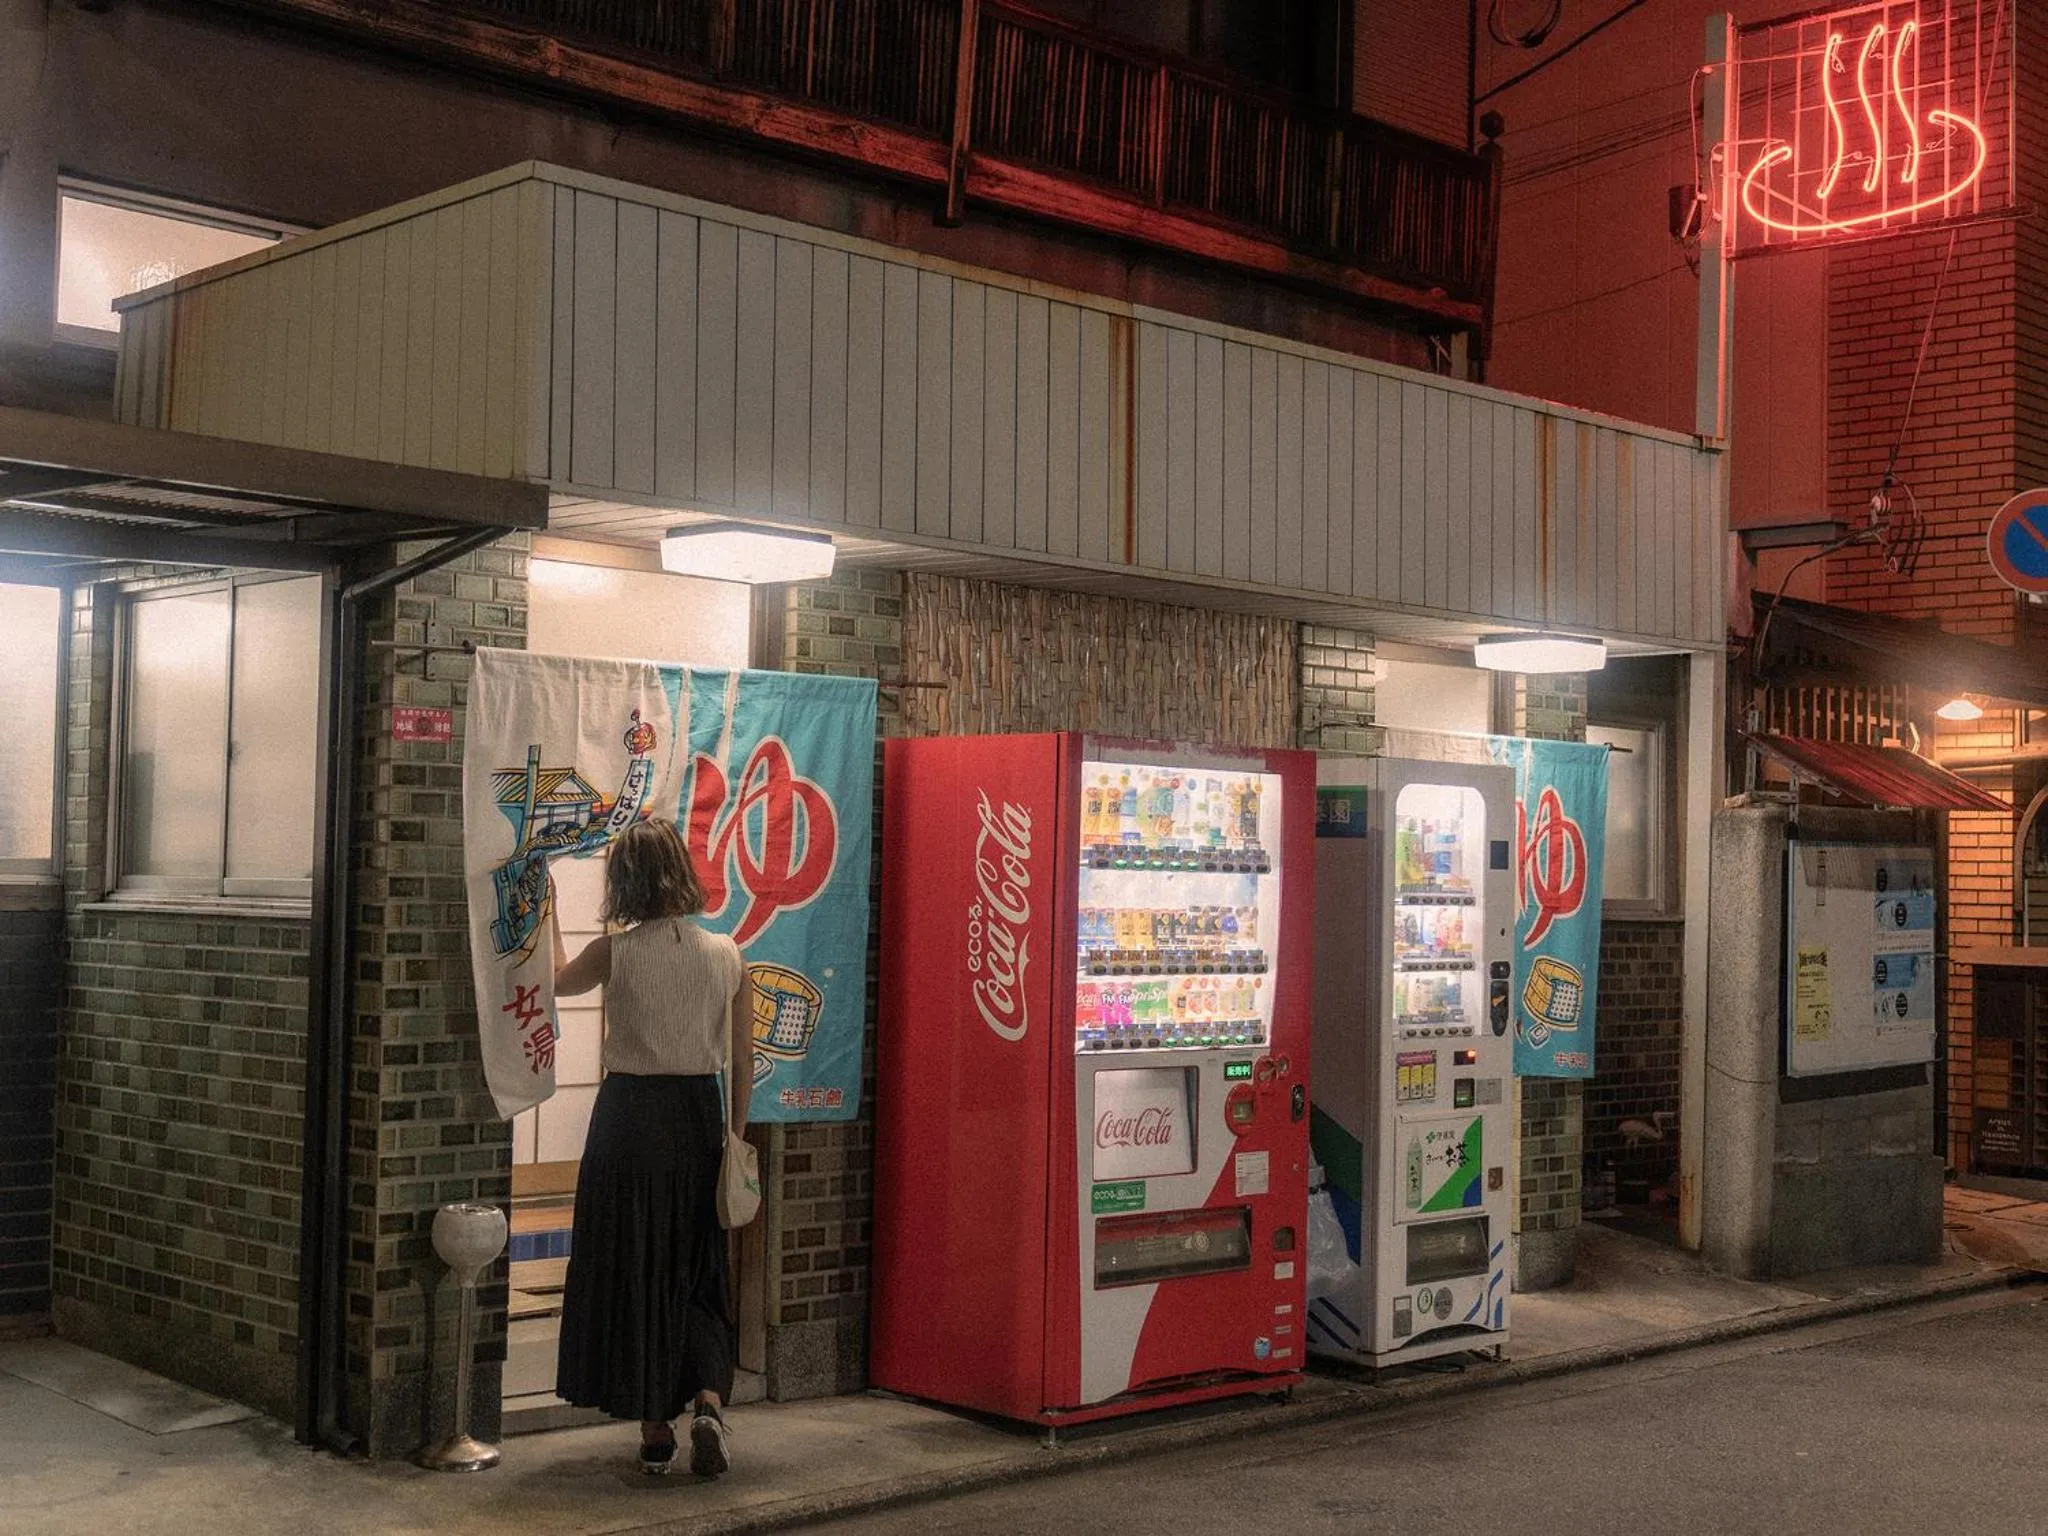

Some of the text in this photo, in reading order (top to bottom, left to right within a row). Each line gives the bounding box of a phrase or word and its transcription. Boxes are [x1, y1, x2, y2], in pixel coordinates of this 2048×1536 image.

[686, 737, 838, 949] ゆ
[973, 786, 1032, 1041] Coca-Cola
[1516, 785, 1588, 951] ゆ
[502, 984, 555, 1075] 女湯
[1096, 1107, 1175, 1149] Coca-Cola
